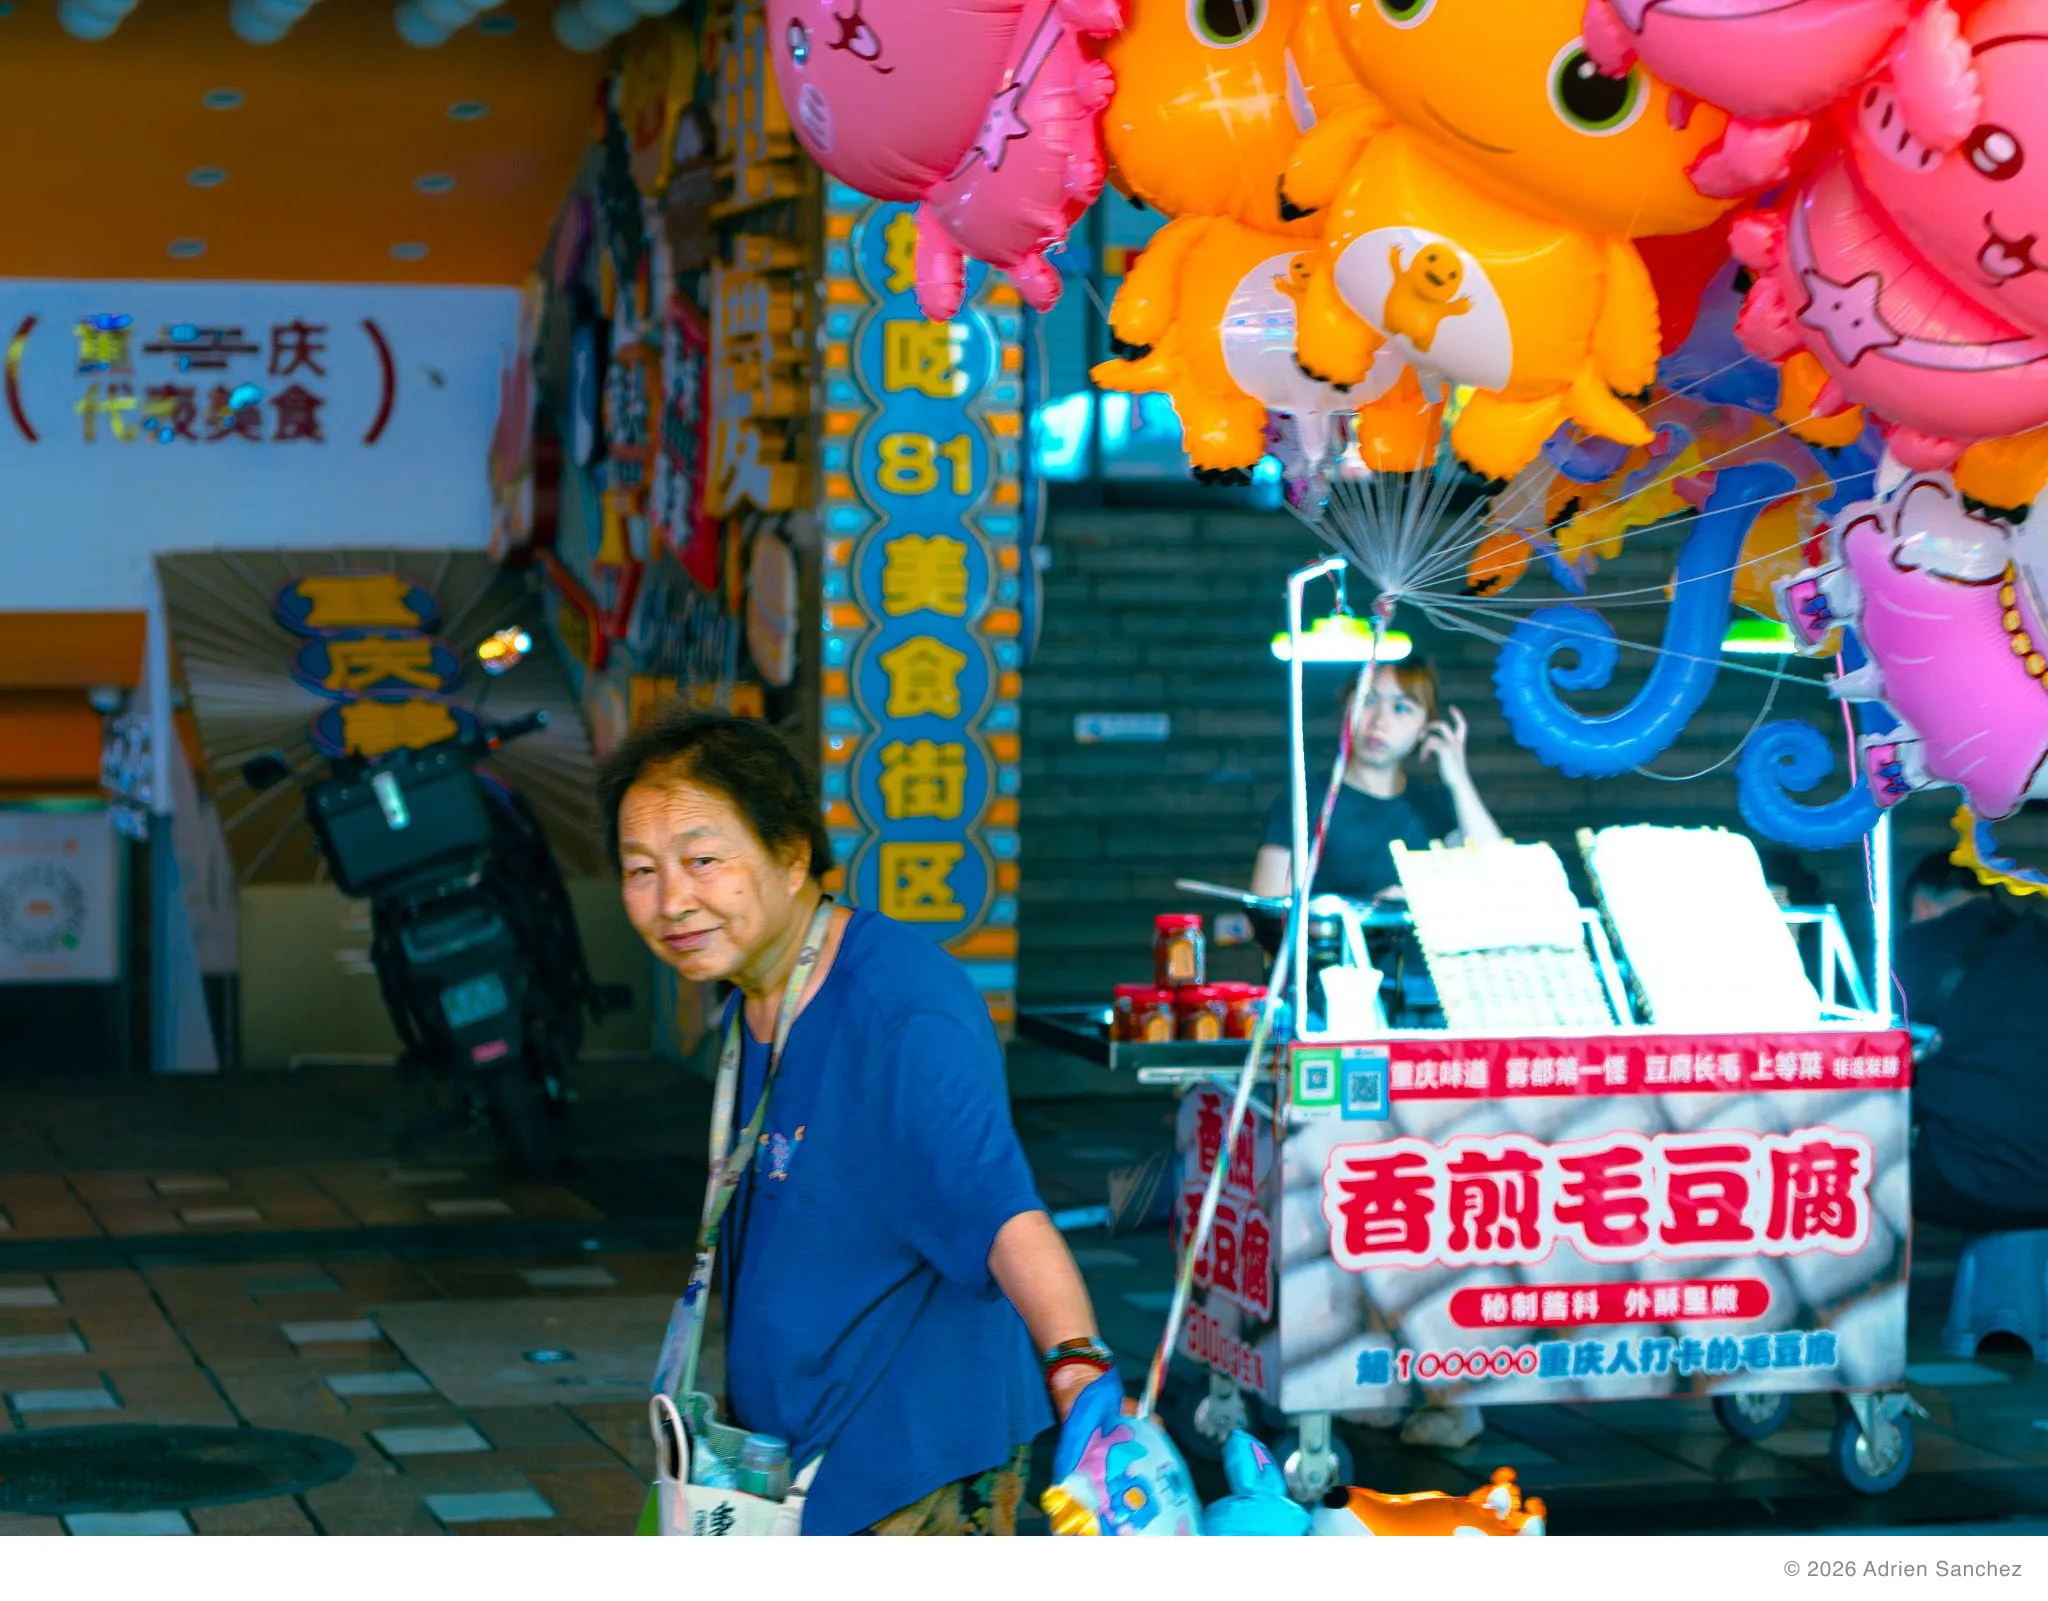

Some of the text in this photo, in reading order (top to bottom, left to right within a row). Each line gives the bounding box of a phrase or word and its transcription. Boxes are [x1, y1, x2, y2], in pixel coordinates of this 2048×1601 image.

[1390, 1059, 1489, 1091] 重庆味道
[1644, 1052, 1743, 1084] 豆腐长毛
[1750, 1050, 1824, 1082] 上等菜
[1337, 1140, 1861, 1256] 香煎毛豆腐
[1480, 1283, 1740, 1324] 秘制酱料 外酥里嫩
